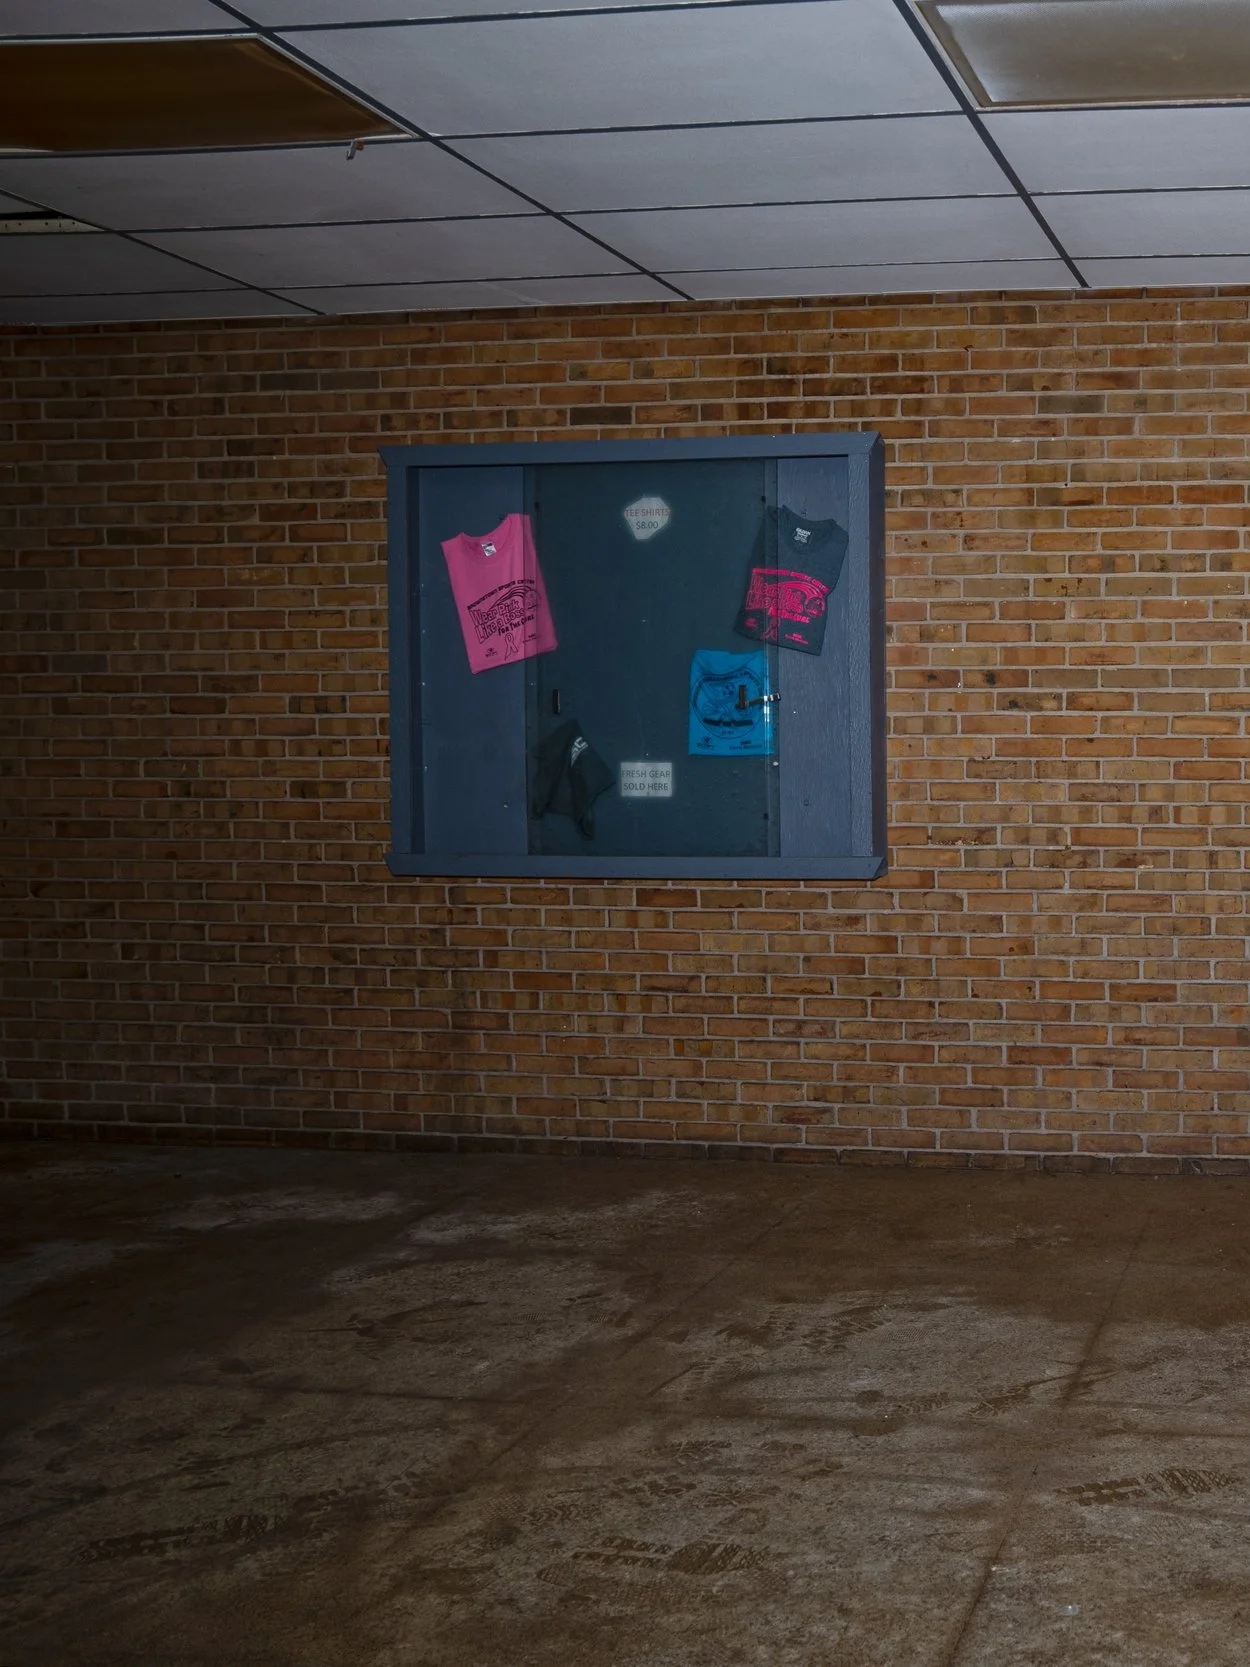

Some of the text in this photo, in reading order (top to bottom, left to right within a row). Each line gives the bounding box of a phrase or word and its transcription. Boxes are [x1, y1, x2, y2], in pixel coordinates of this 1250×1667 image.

[624, 508, 671, 517] TEE SHIRTS
[636, 521, 659, 530] $8.00
[469, 599, 520, 626] Wear Pink
[475, 622, 498, 645] Like
[503, 608, 526, 624] Boss
[622, 770, 671, 778] FRESH GEAR
[648, 783, 669, 791] HERE
